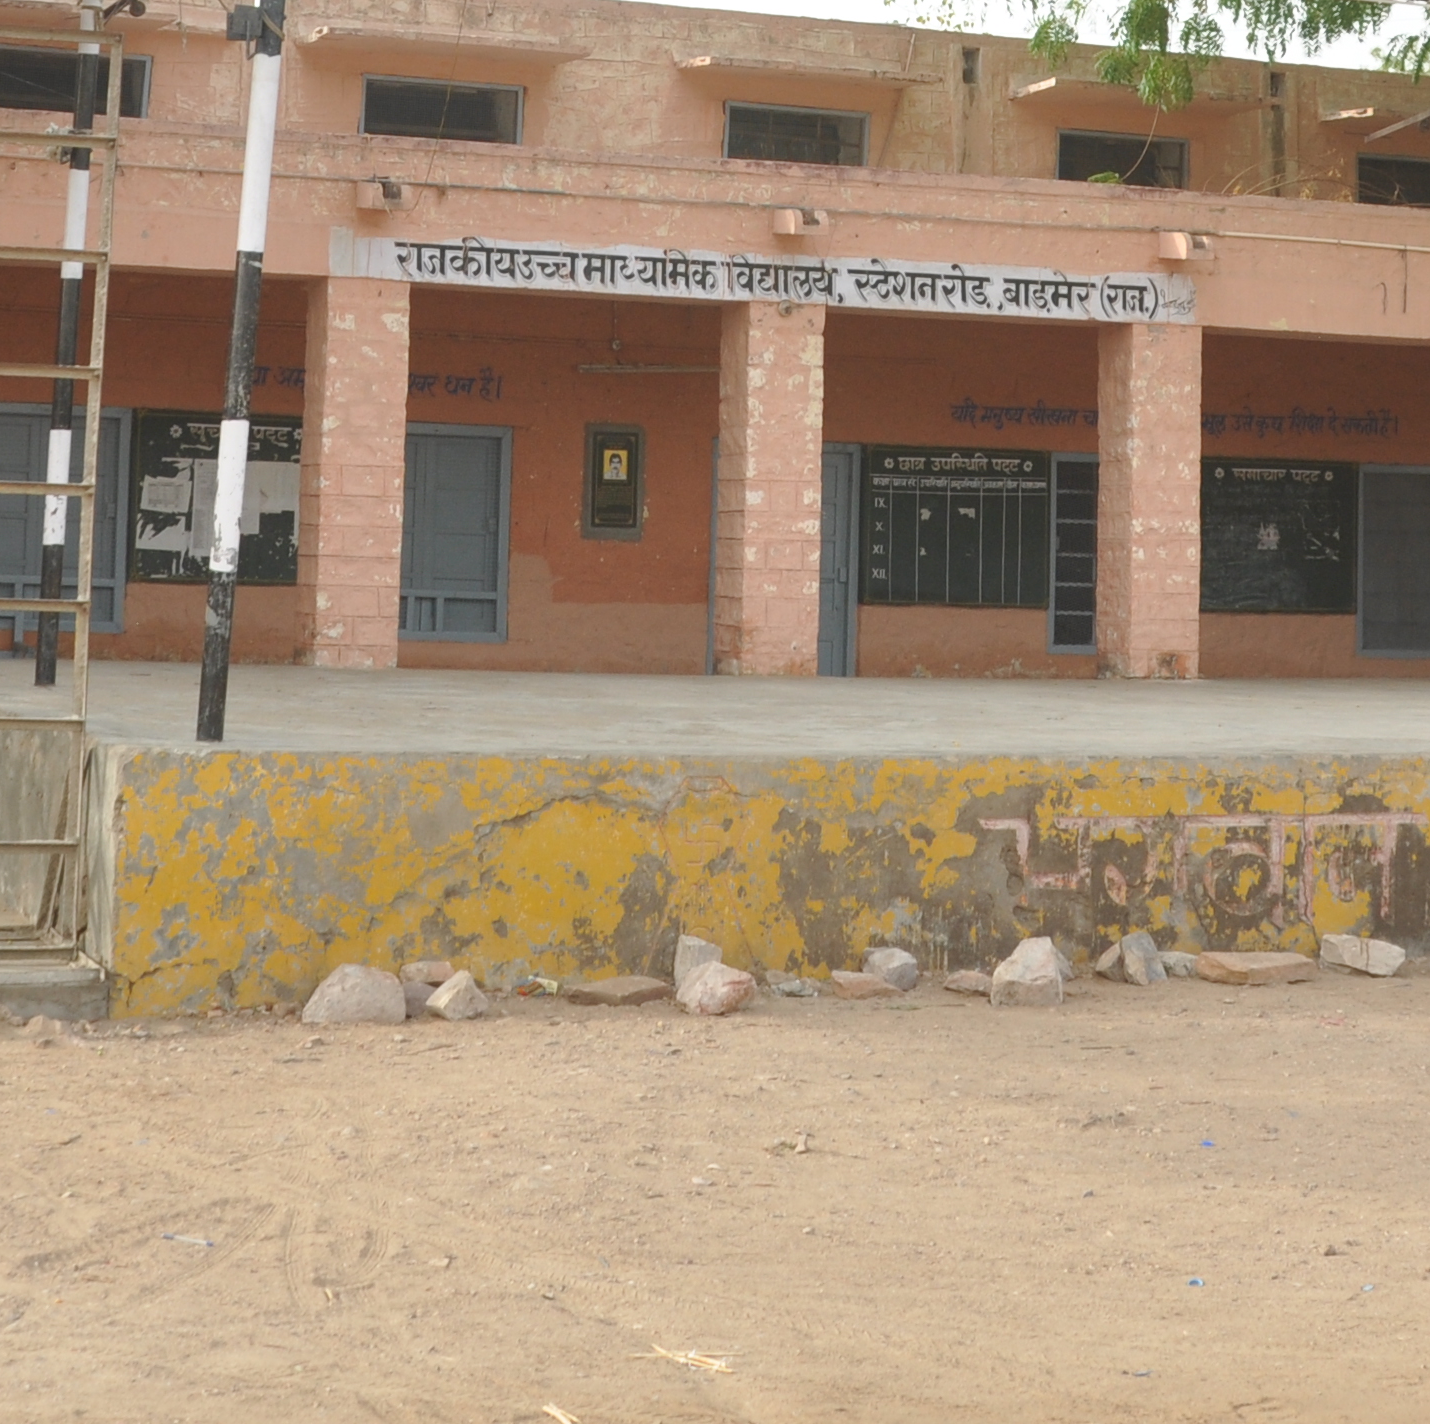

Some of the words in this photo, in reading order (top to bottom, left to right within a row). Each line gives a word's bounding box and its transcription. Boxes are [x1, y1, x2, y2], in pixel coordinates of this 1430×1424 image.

[394, 236, 519, 279] राजकीय
[517, 248, 577, 283] उच्च
[581, 248, 718, 291] माध्यमिक
[847, 258, 938, 303] स्टेशन
